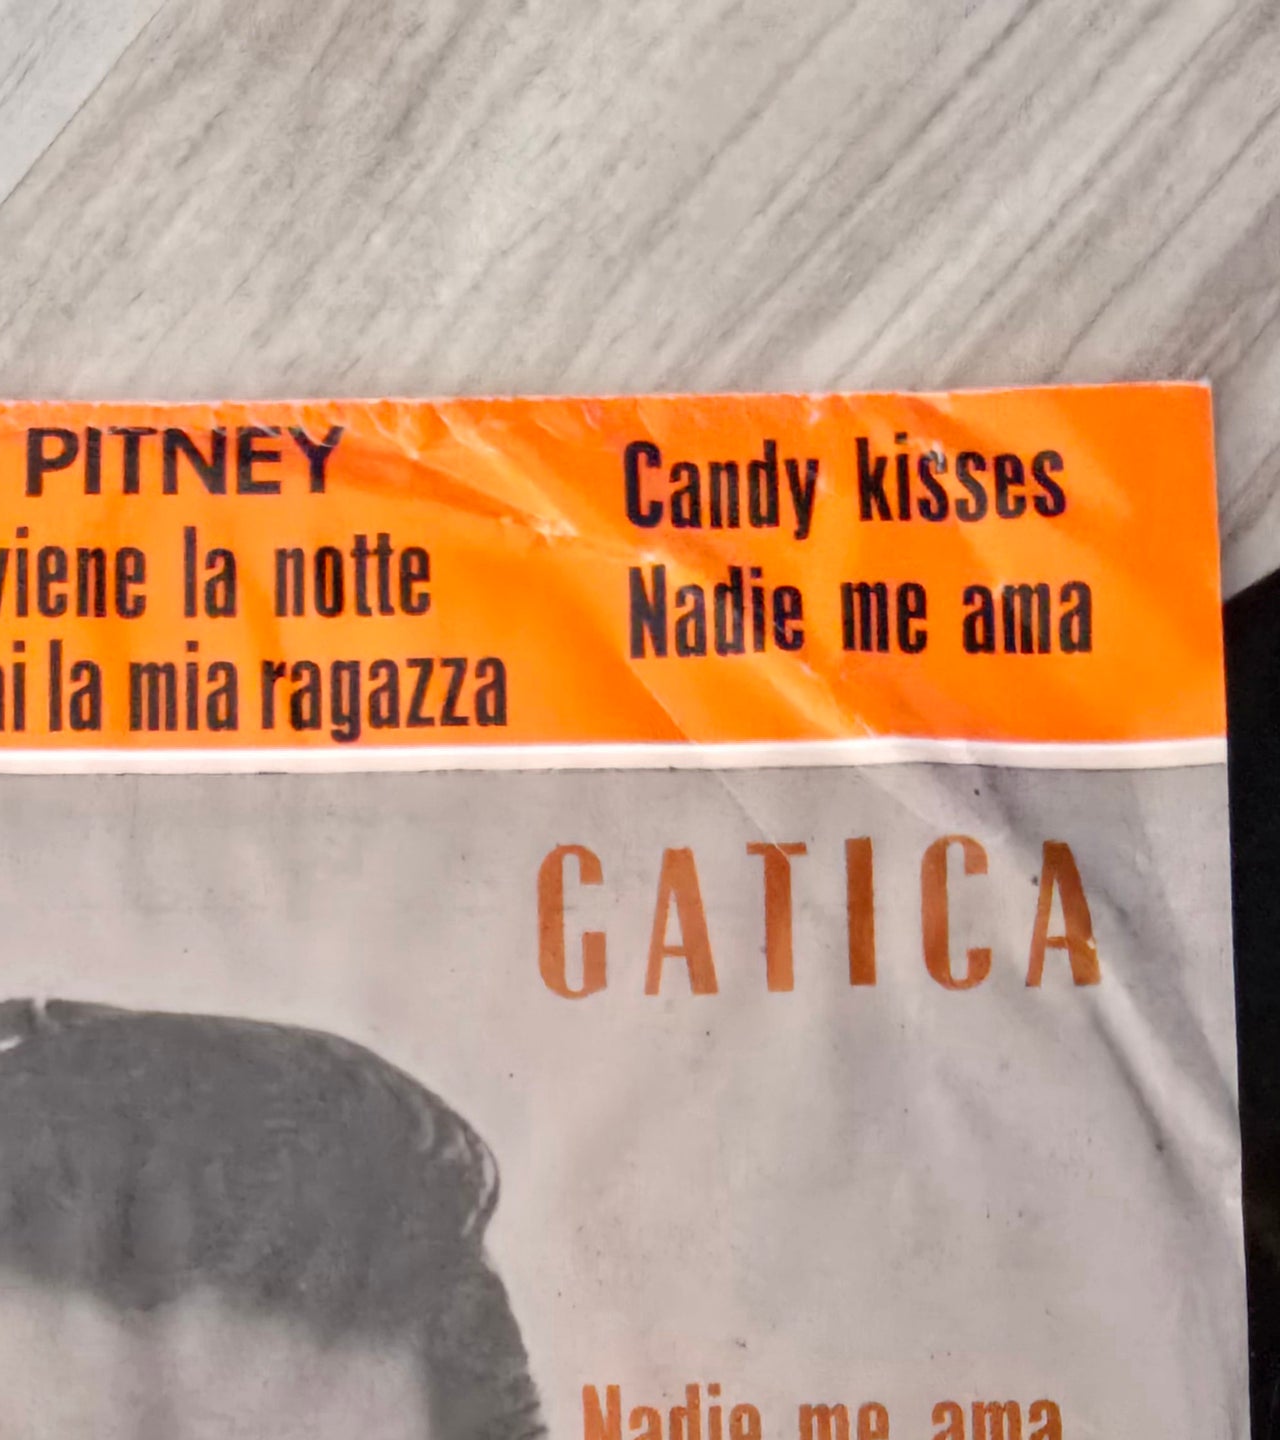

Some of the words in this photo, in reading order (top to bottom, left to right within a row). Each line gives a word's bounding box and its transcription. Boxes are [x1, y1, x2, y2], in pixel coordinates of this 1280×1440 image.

[28, 427, 341, 494] PITNEY
[625, 440, 817, 539] Candy
[857, 433, 1065, 521] kisses
[186, 528, 235, 615] la
[277, 534, 428, 616] notte
[631, 567, 803, 656] Nadie
[842, 583, 926, 653] me
[964, 582, 1090, 653] ama
[51, 641, 100, 730] la
[131, 642, 236, 729] mia
[264, 658, 506, 741] ragazza
[536, 833, 1102, 1000] GATICA
